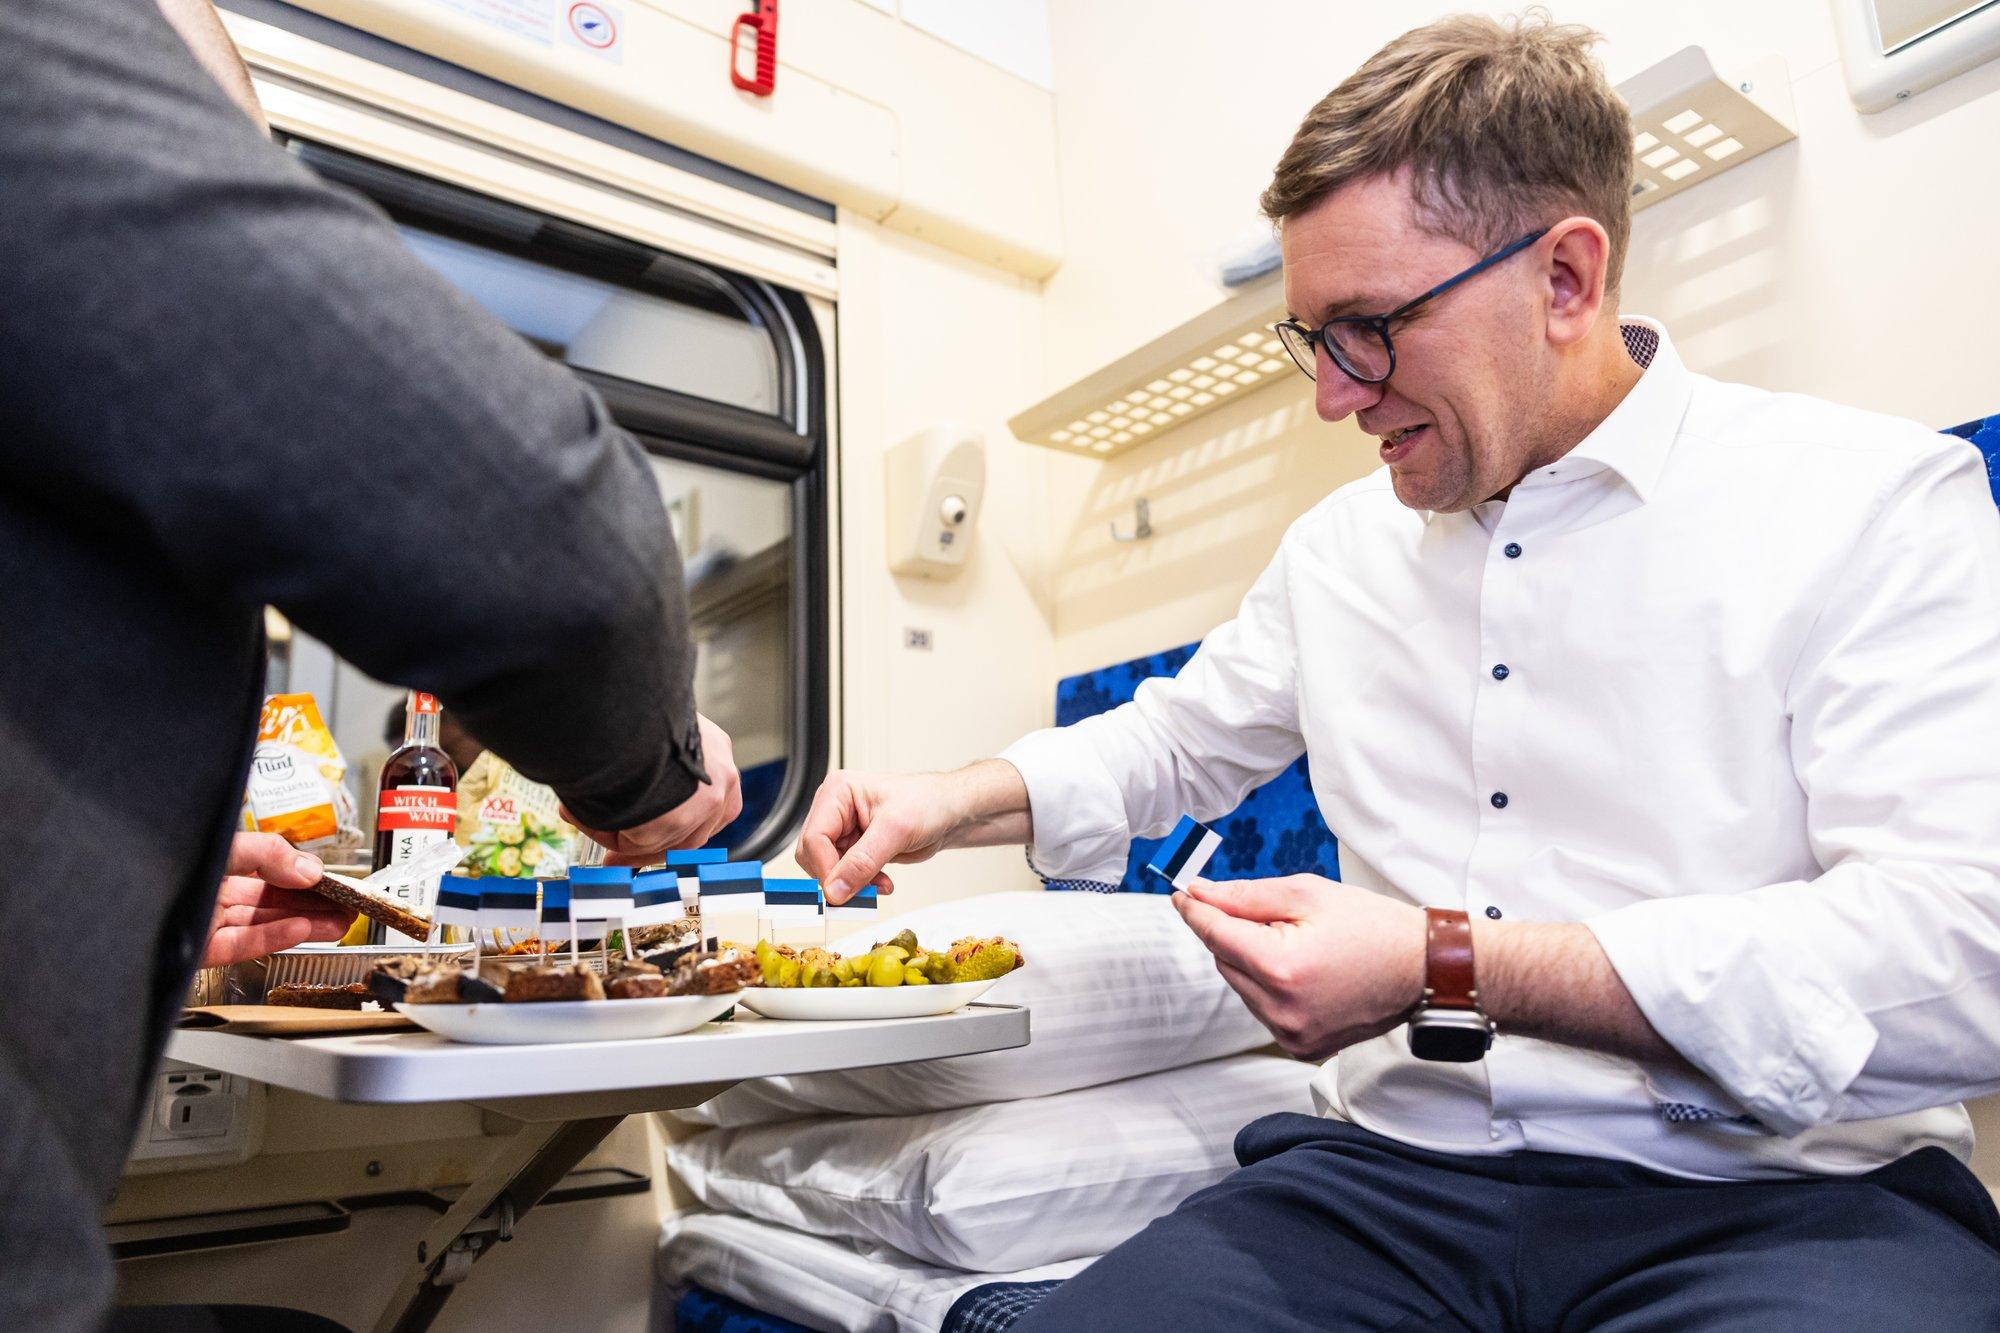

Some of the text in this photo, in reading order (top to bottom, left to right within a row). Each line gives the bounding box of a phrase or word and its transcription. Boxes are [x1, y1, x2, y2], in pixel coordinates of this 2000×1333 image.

[254, 754, 294, 775] Flint
[393, 795, 438, 807] WITCH
[408, 811, 449, 824] WATER
